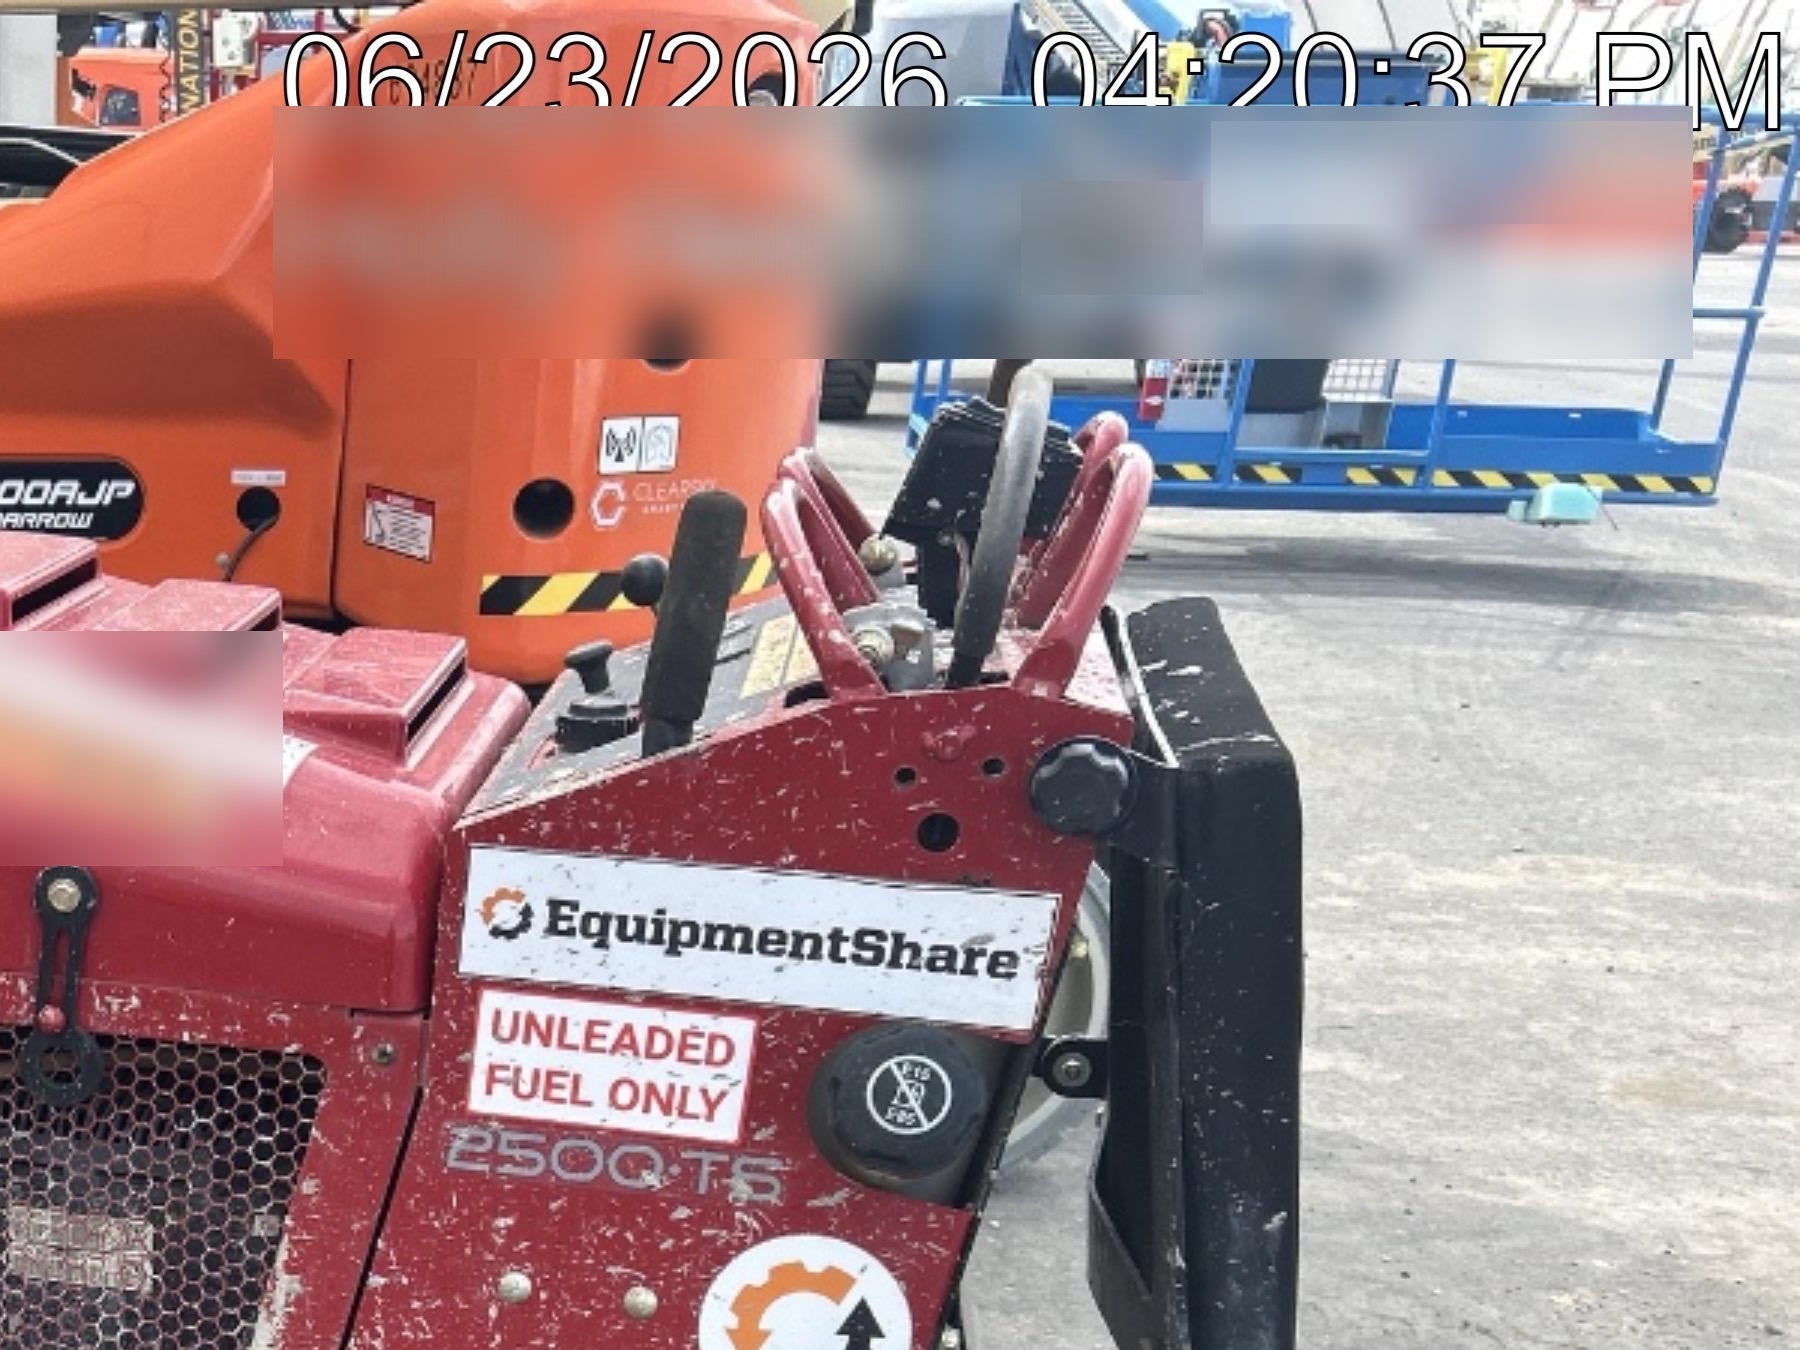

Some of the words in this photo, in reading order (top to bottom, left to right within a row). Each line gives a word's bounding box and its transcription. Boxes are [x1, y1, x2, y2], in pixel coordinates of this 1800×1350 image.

[545, 898, 1021, 980] EquipmentShare
[490, 1008, 737, 1068] UNLEADED
[484, 1062, 594, 1108] FUEL
[608, 1075, 730, 1123] ONLY
